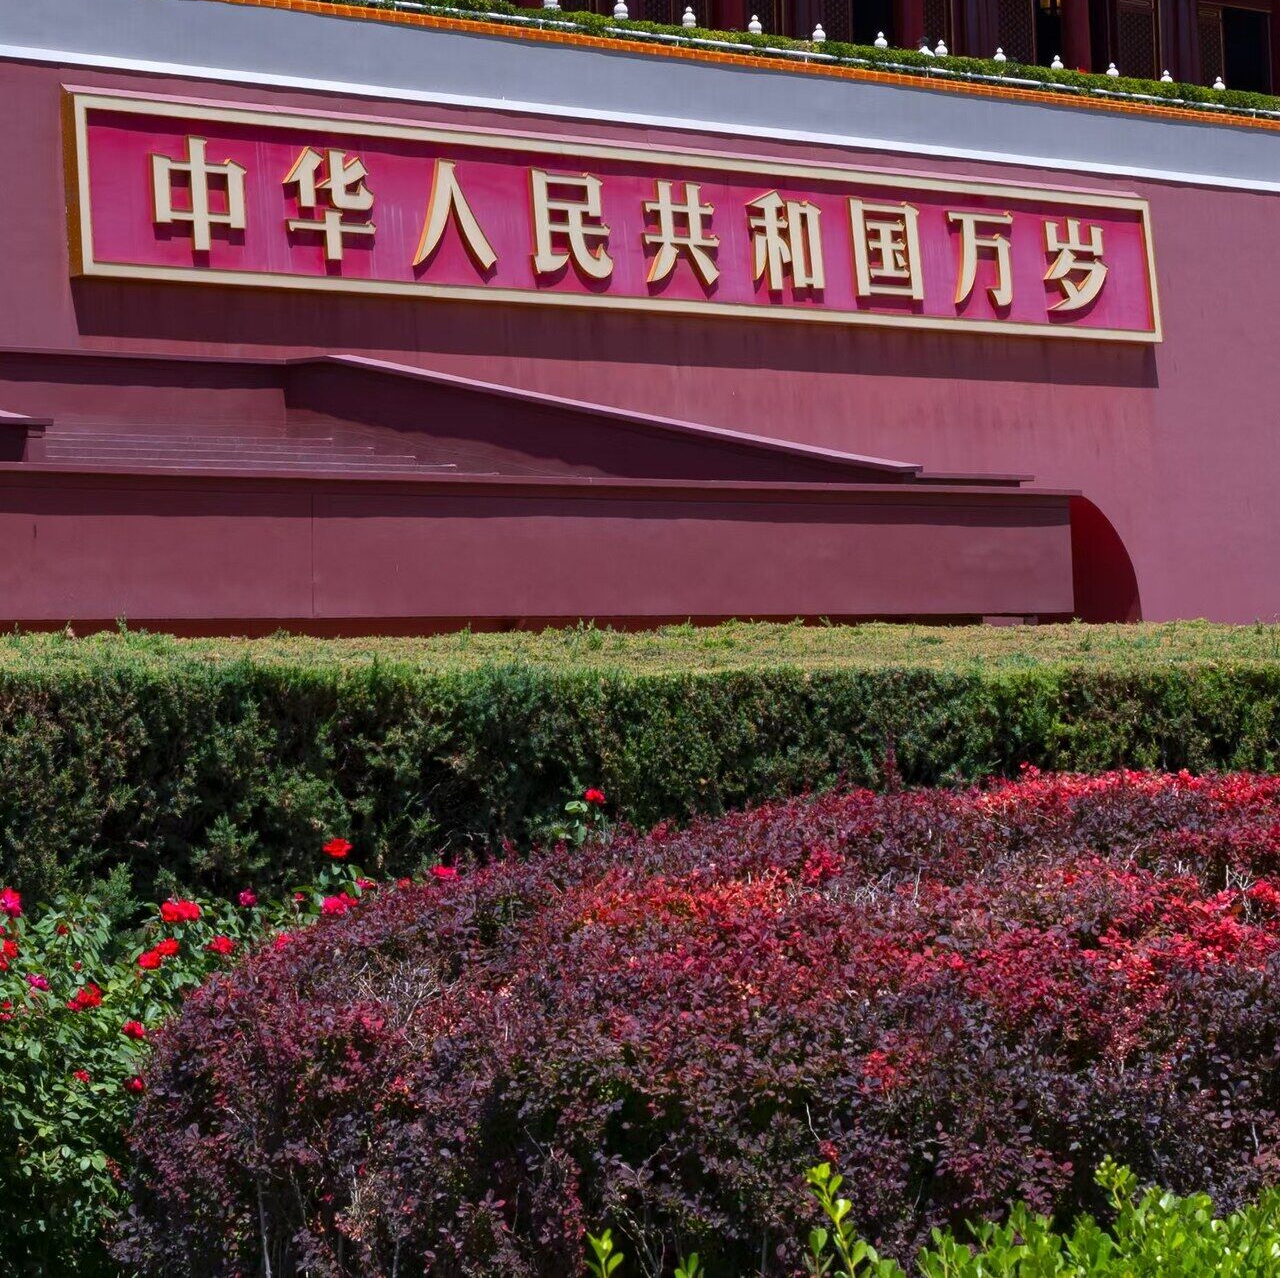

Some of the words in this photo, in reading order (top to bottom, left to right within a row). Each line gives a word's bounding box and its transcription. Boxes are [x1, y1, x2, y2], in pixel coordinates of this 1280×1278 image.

[150, 135, 1110, 312] 中华人民共和国万岁
